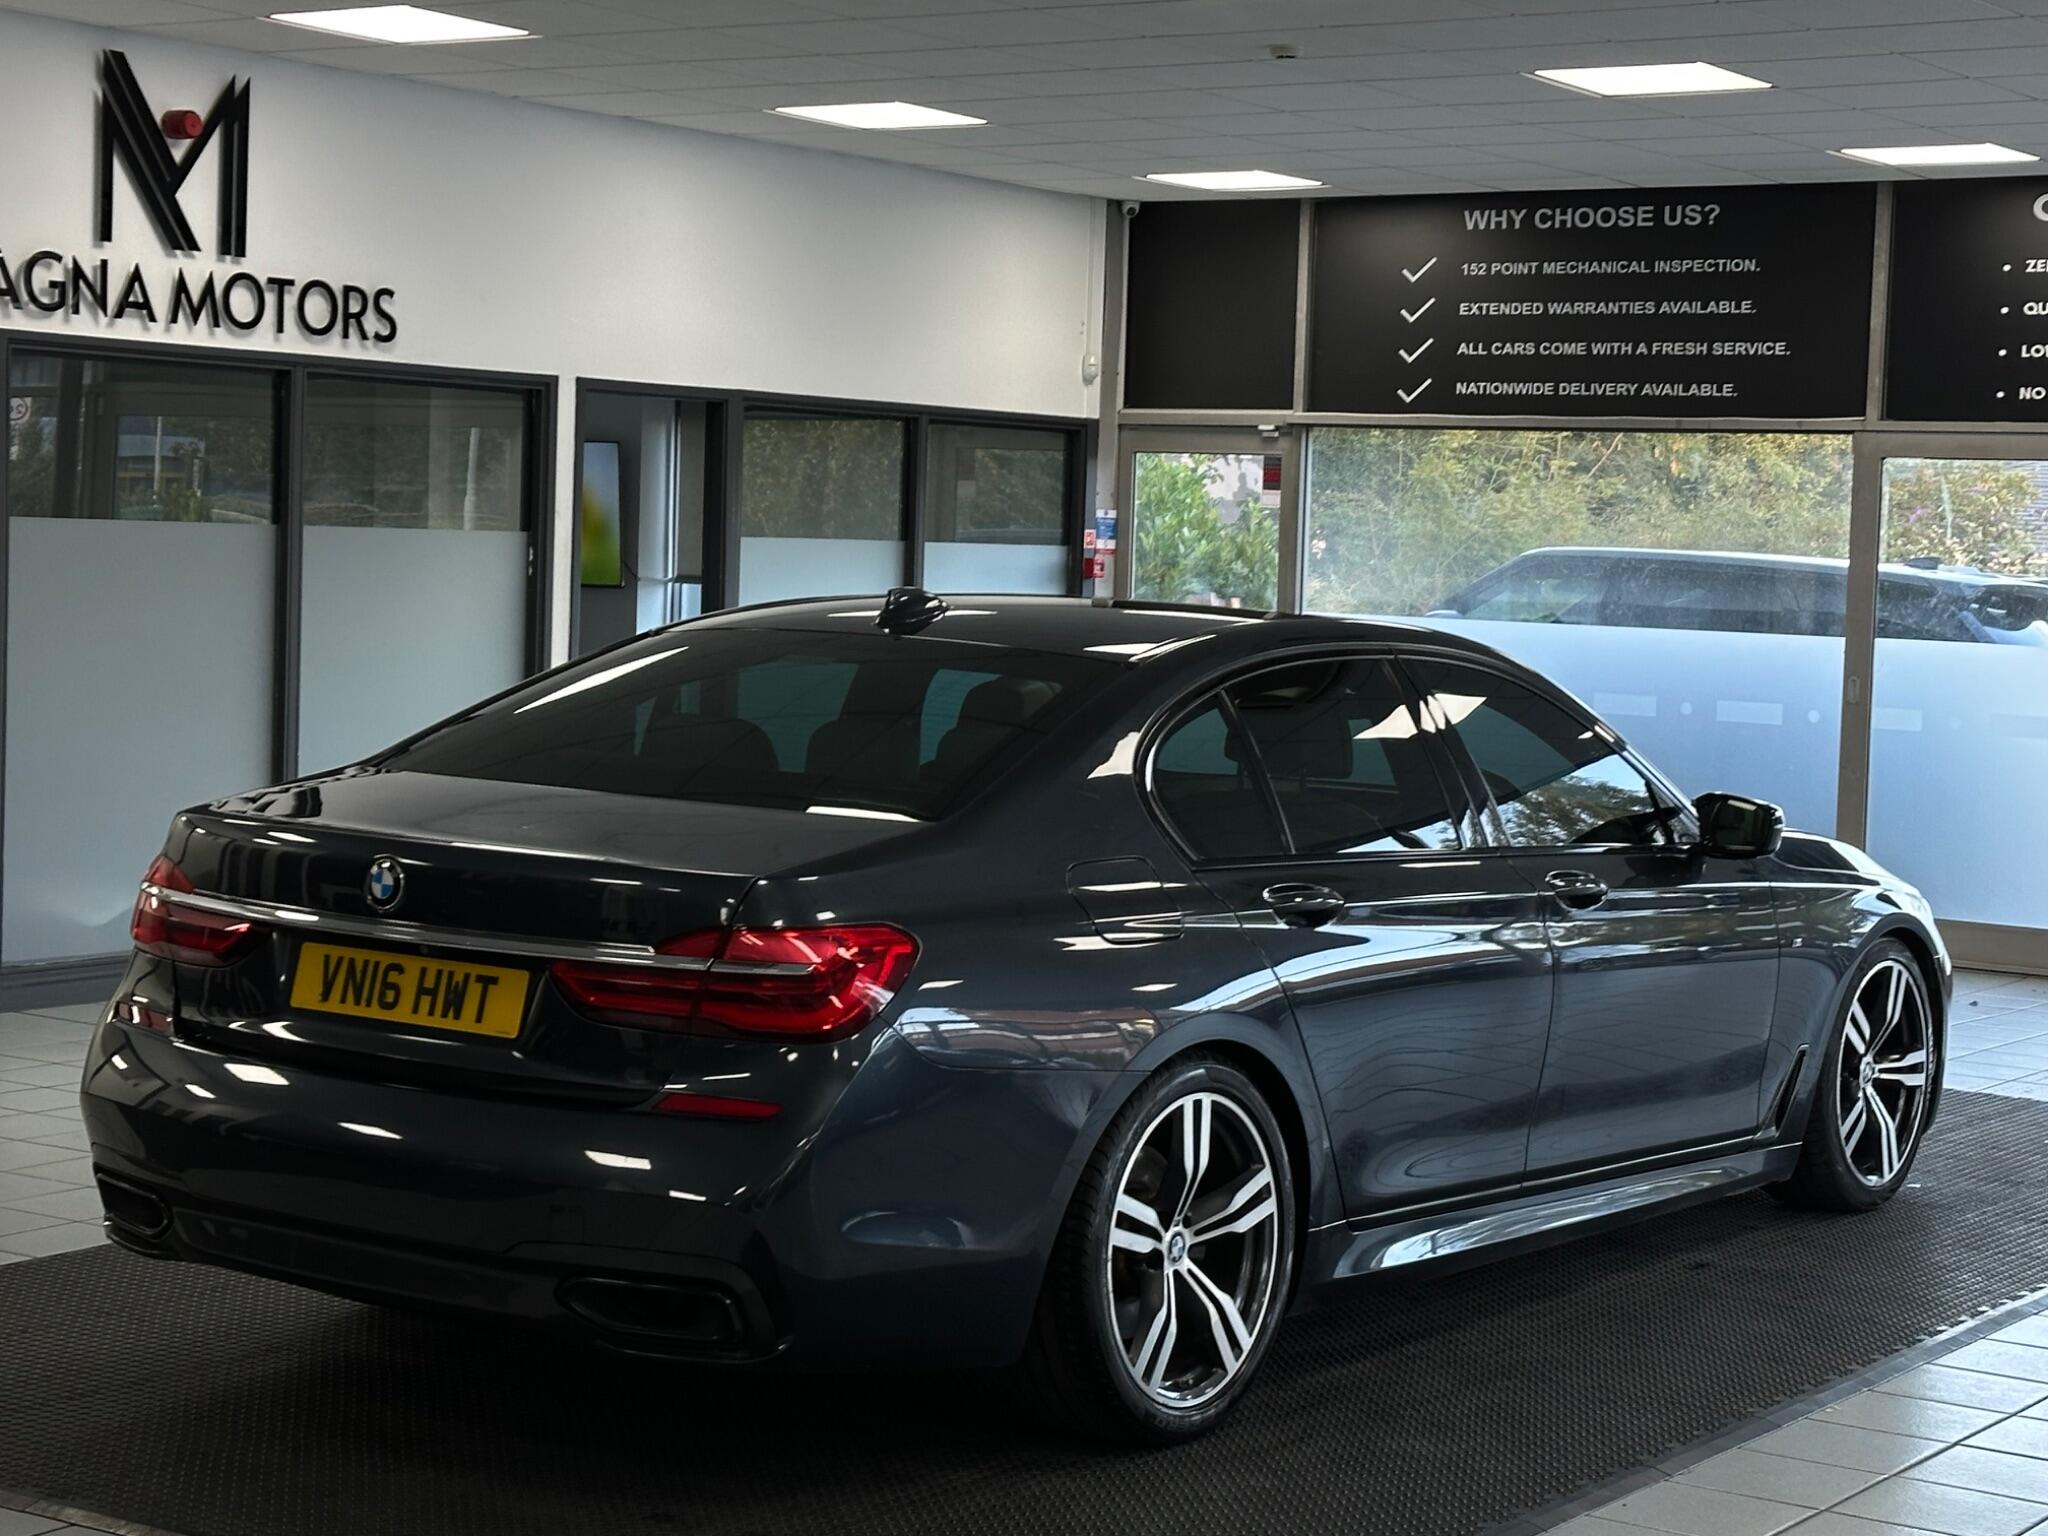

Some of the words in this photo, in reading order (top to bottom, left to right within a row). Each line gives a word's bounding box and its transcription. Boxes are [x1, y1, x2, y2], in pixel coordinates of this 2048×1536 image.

[1464, 208, 1528, 231] WHY
[1534, 206, 1654, 229] CHOOSE
[1664, 204, 1720, 226] US?
[1461, 263, 1487, 276] 152
[1490, 262, 1539, 275] POINT
[1542, 260, 1650, 275] MECHANICAL
[1654, 258, 1761, 273] INSPECTION.
[169, 267, 397, 343] MOTORS
[1459, 302, 1543, 315] EXTENDED
[1547, 301, 1655, 315] WARRANTIES
[1658, 300, 1757, 314] AVAILABLE.
[1456, 342, 1488, 355] ALL
[1491, 342, 1535, 355] CARS
[1539, 342, 1587, 355] COME
[1591, 342, 1632, 355] WITH
[1635, 342, 1648, 355] A
[1651, 342, 1708, 355] FRESH
[1711, 342, 1791, 355] SERVICE.
[1455, 382, 1555, 395] NATIONWIDE
[1558, 382, 1638, 395] DELIVERY
[1640, 383, 1738, 396] AVAILABLE.
[2019, 386, 2047, 400] NO
[319, 954, 405, 1011] VN16
[411, 966, 499, 1024] HWT
